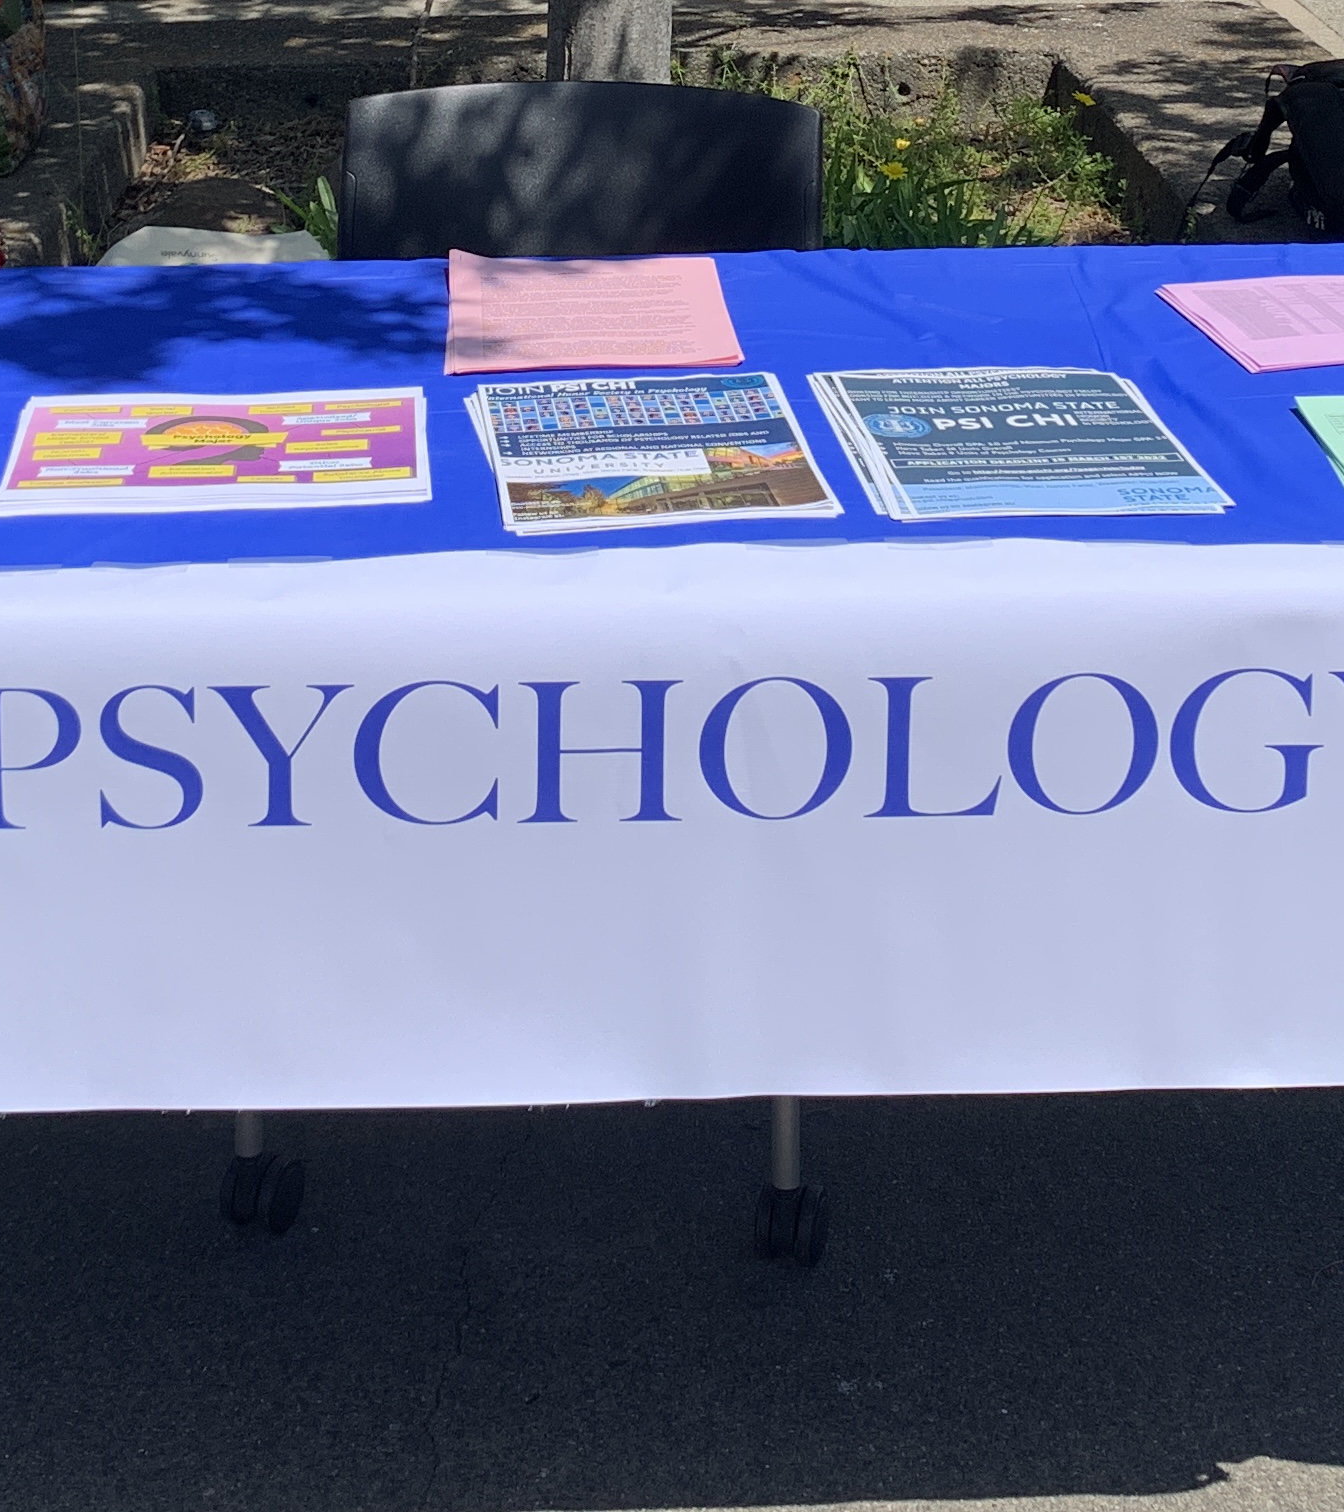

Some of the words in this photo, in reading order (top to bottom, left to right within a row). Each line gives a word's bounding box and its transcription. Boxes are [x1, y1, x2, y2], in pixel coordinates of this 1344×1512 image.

[986, 372, 1067, 382] PSYCHOLOGY
[486, 384, 546, 396] JOIN
[550, 381, 589, 394] PSI
[591, 380, 637, 392] CHI
[556, 390, 591, 398] Honor
[592, 389, 632, 397] Society
[647, 386, 709, 395] Psychology
[959, 380, 1010, 390] MAJORS
[887, 406, 946, 415] JOIN
[950, 401, 1049, 414] SONOMA
[1052, 400, 1121, 410] STATE
[932, 416, 995, 430] PSI
[1006, 413, 1079, 427] CHI
[522, 448, 583, 456] NETWORKING
[704, 438, 767, 447] CONVENTIONS
[501, 453, 618, 467] SONOMA
[623, 449, 700, 461] STATE
[533, 461, 665, 475] UNIVERSITY
[1117, 486, 1217, 496] SONOMA
[1123, 493, 1190, 503] STATE
